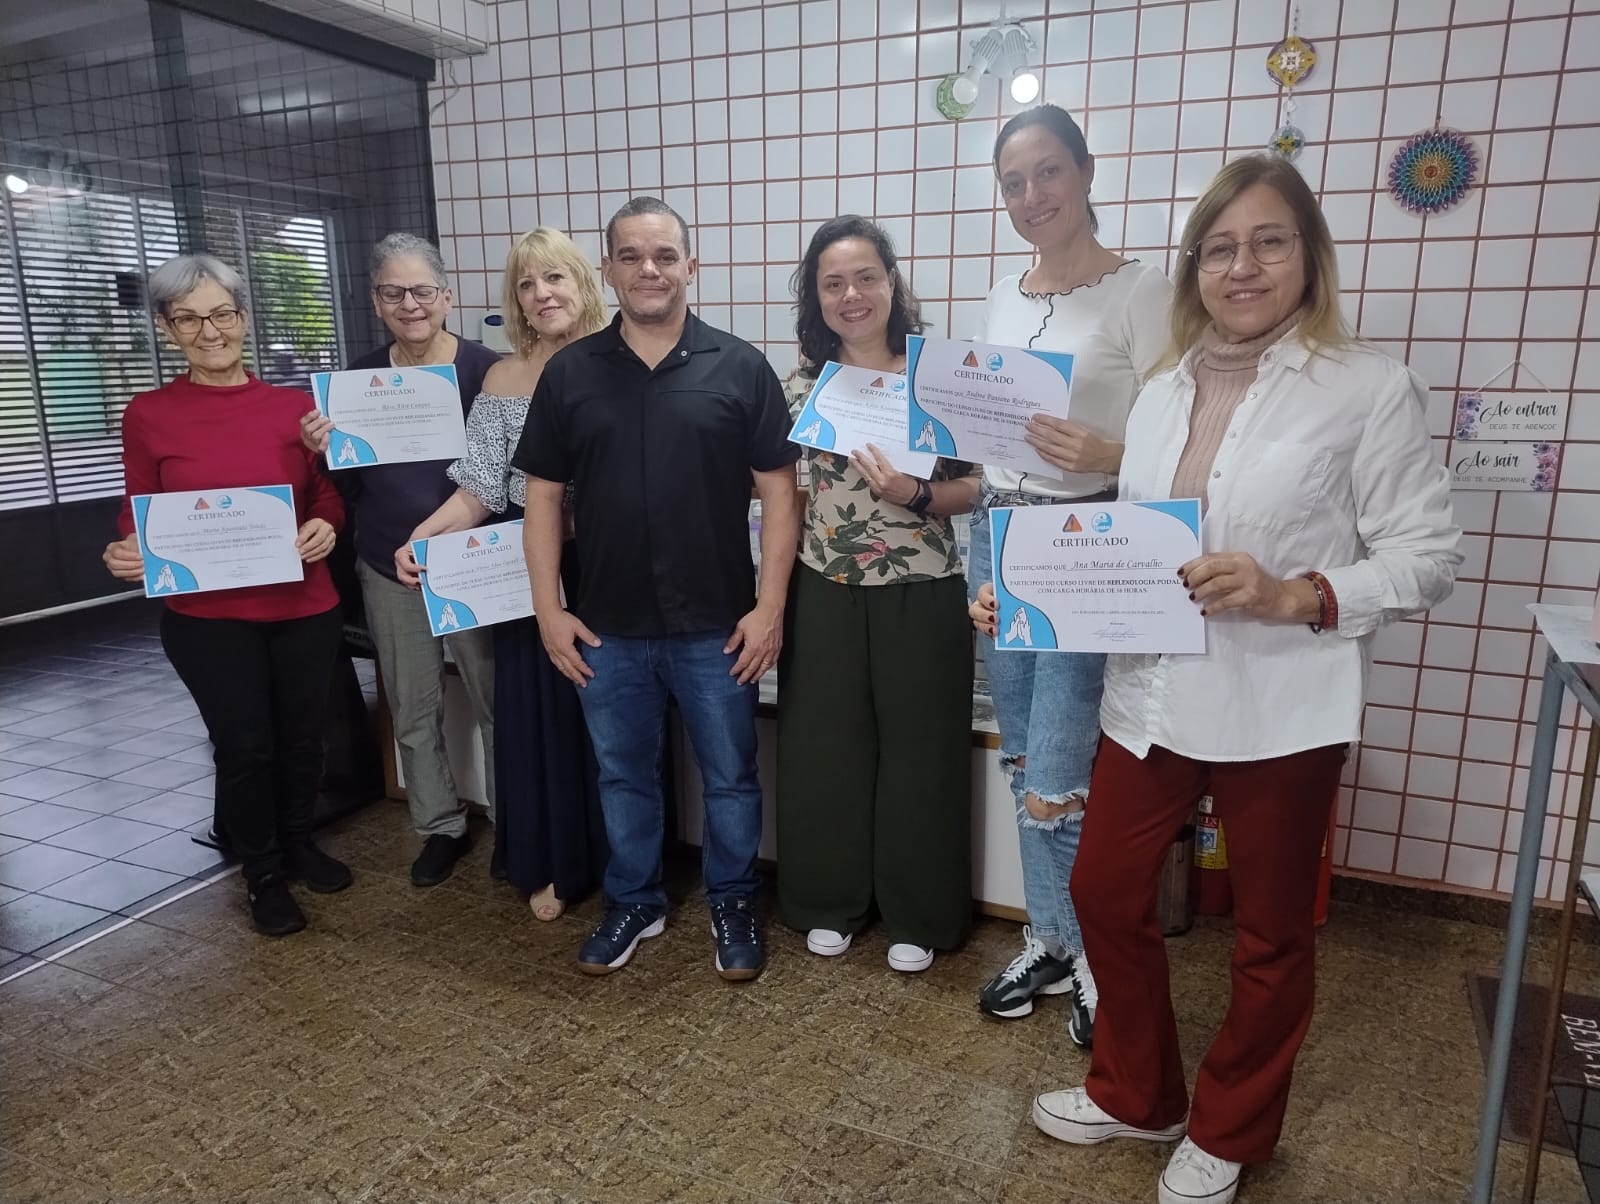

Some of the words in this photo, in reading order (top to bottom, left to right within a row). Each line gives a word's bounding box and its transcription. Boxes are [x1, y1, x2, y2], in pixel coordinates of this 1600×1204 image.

[954, 369, 1014, 385] CERTIFICADO
[364, 388, 416, 398] CERTIFICADO
[1480, 400, 1511, 423] Ao
[1515, 400, 1558, 417] entrar
[1525, 423, 1558, 431] ABENÇOE
[1456, 450, 1489, 475] Ao
[1493, 453, 1520, 468] sair
[187, 510, 246, 521] CERTIFICADO
[1052, 536, 1129, 548] CERTIFICADO
[461, 544, 512, 560] CERTIFICADO
[1053, 564, 1066, 572] QUE
[1072, 560, 1088, 570] Ana
[1090, 560, 1114, 569] Maria
[1116, 559, 1125, 568] de
[1126, 558, 1163, 569] Carvalho
